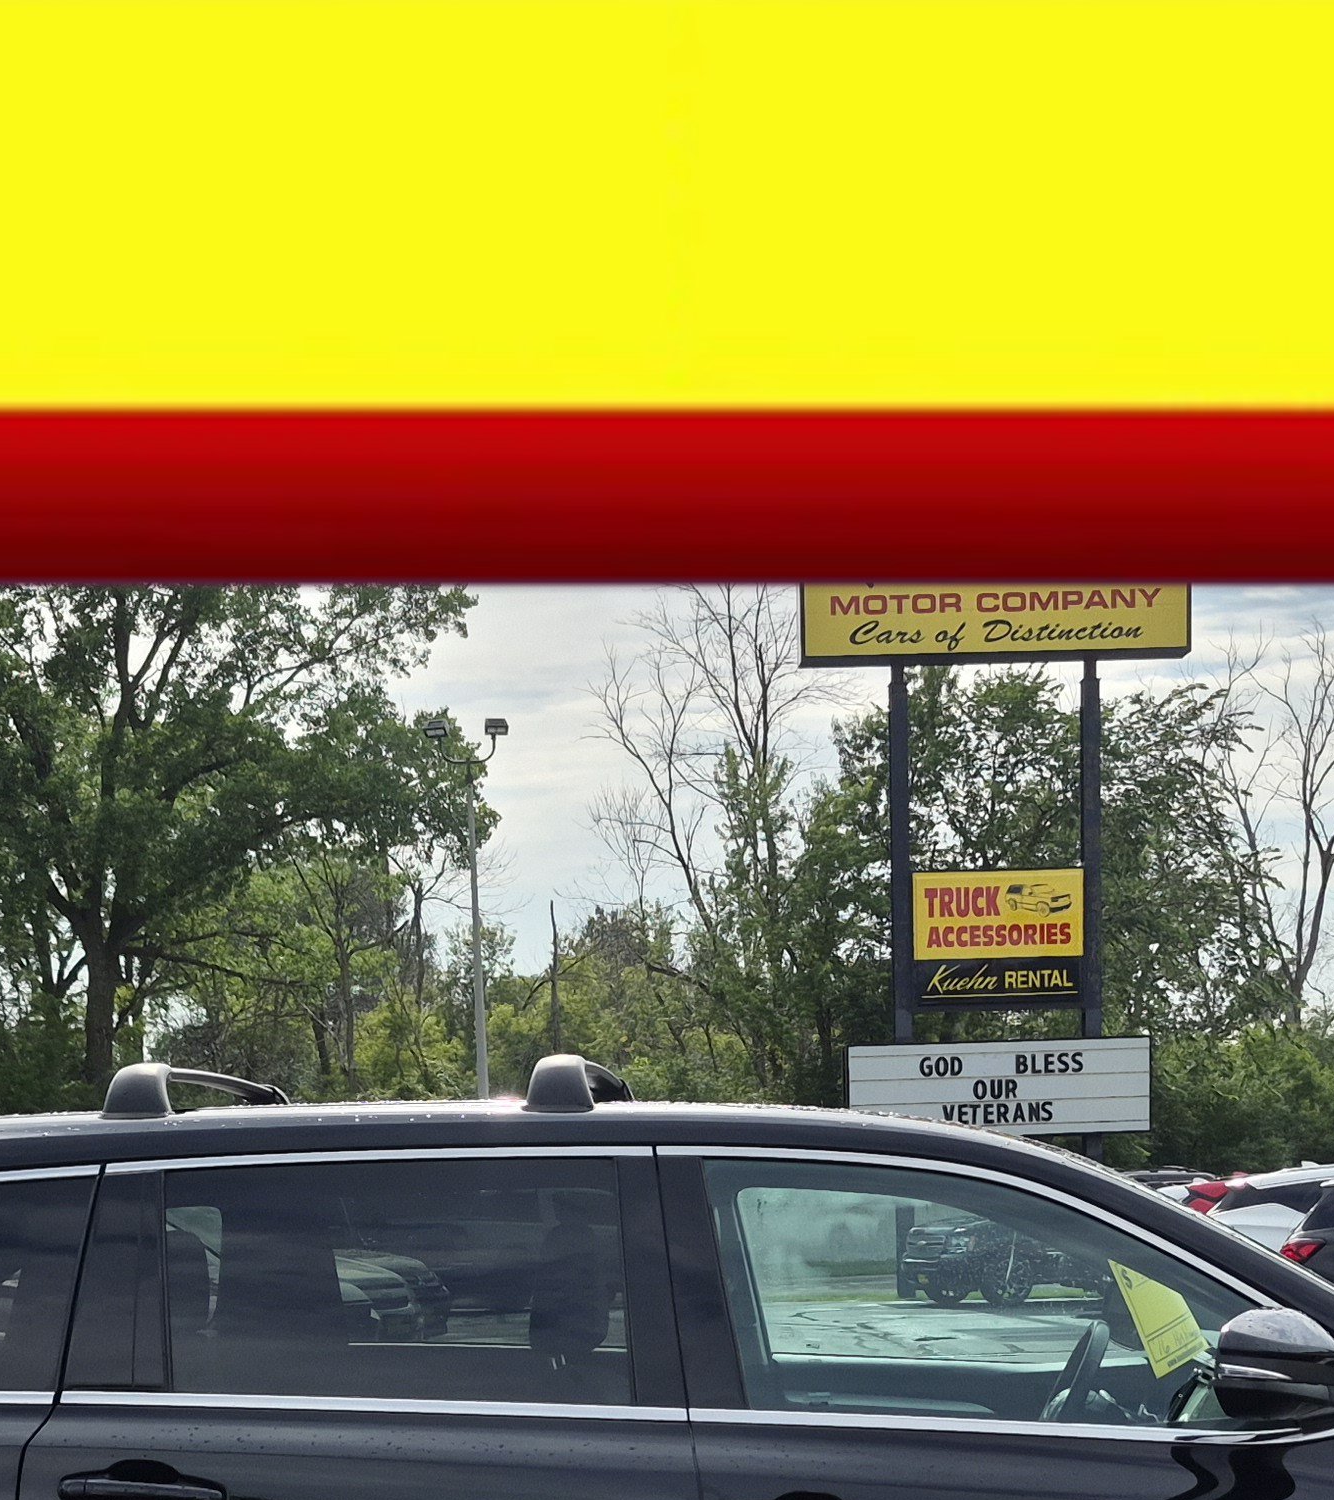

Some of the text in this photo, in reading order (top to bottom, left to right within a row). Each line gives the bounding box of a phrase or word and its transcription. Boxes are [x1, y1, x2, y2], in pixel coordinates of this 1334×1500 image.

[830, 588, 1162, 616] MOTOR COMPANY
[849, 619, 1144, 649] Cars of Distinction
[924, 886, 1001, 918] TRUCK
[927, 922, 1072, 948] ACCESSORIES
[928, 964, 1073, 993] Kuehn RENTAL
[919, 1052, 1084, 1077] GOD BLESS
[973, 1079, 1018, 1101] OUR
[942, 1101, 1054, 1125] VETERANS
